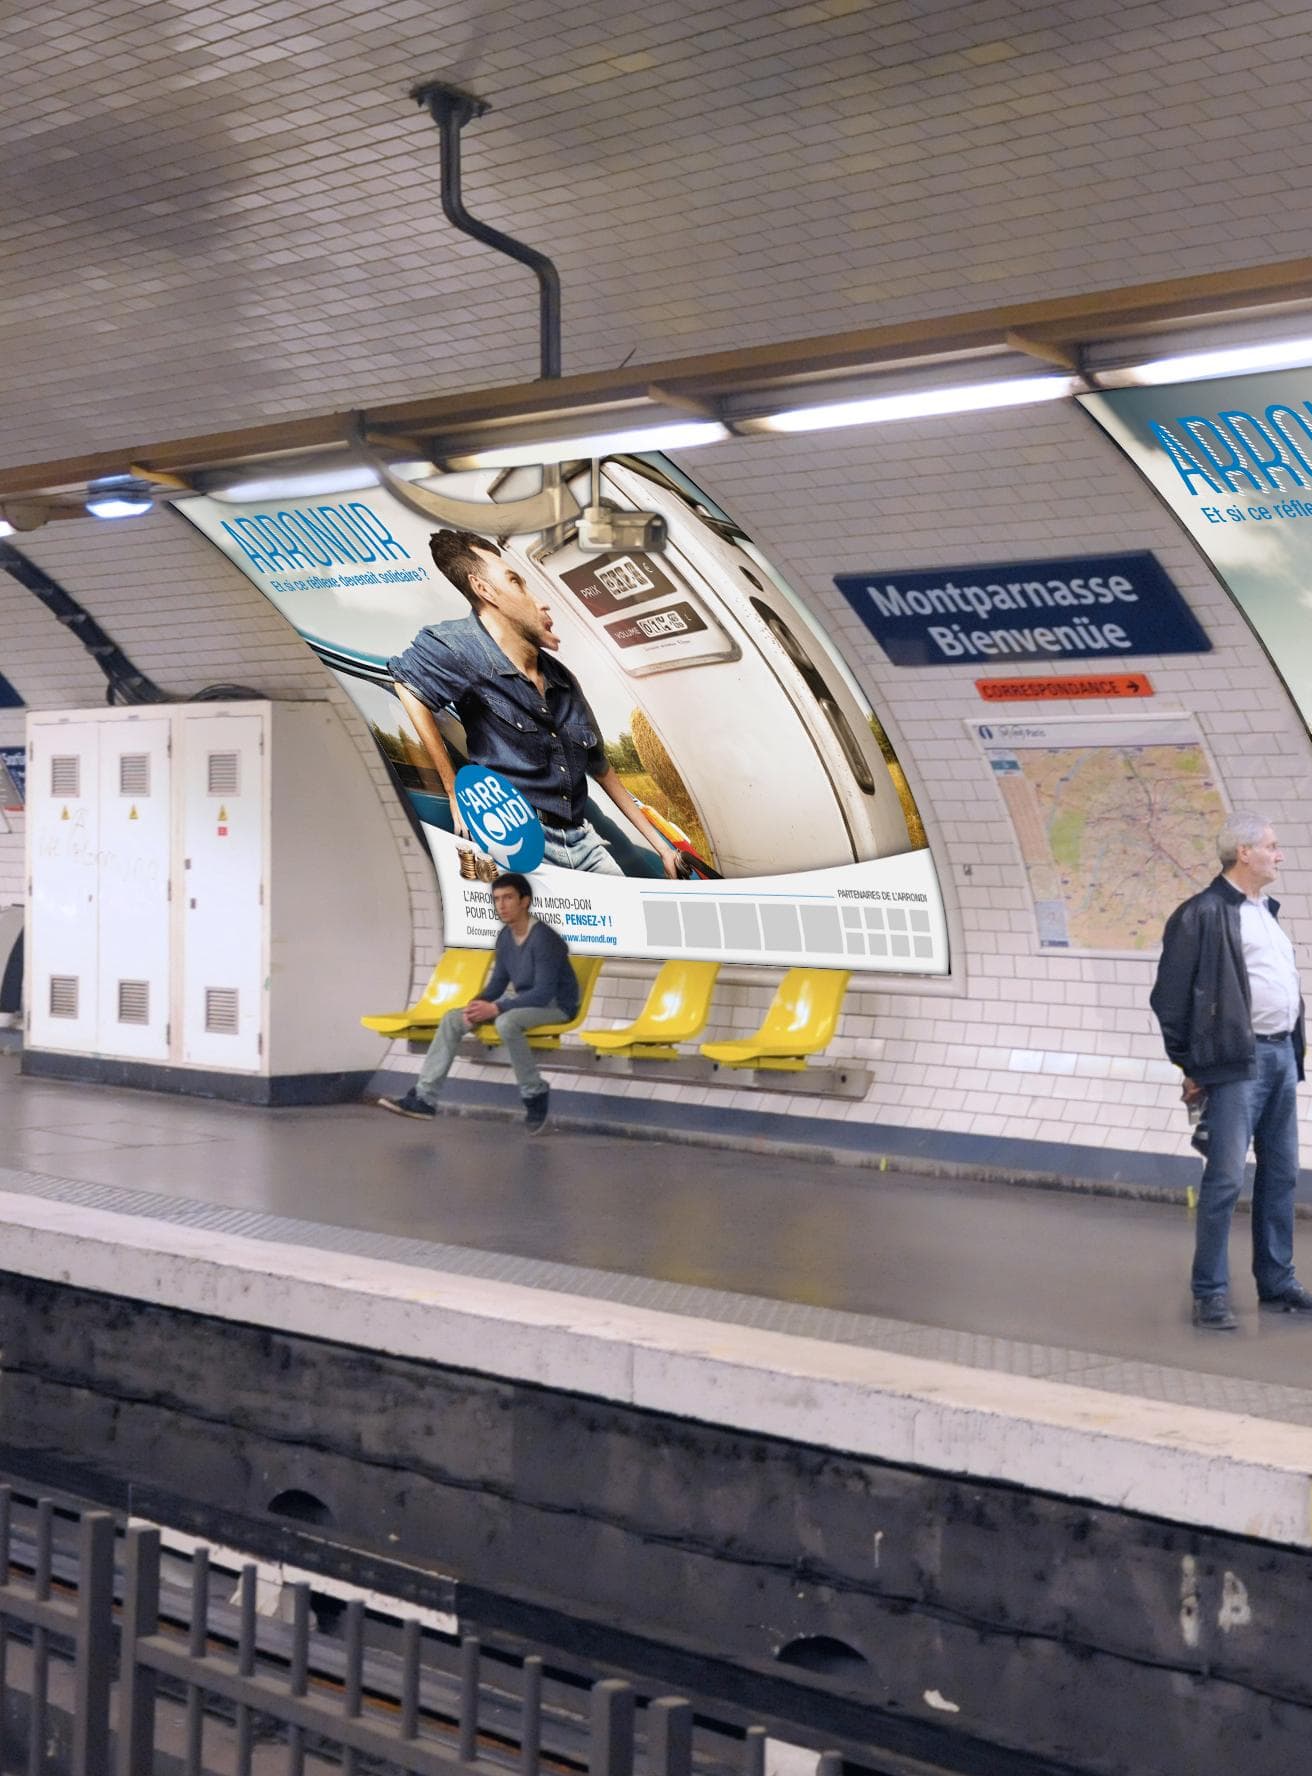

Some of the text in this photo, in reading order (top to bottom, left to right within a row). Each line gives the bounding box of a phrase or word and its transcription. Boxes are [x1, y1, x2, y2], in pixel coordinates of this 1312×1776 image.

[1200, 507, 1227, 524] Et
[1227, 505, 1247, 522] si
[1248, 505, 1272, 521] ce
[220, 502, 411, 574] ARRONDIR
[271, 580, 287, 593] Et
[294, 580, 309, 591] ce
[339, 571, 380, 587] devenait
[379, 568, 423, 585] solidaire
[580, 585, 603, 600] PRIX
[866, 574, 1139, 620] Montparnasse
[927, 616, 1133, 657] Bienvenüe
[982, 681, 1121, 697] CORRESPONDANCE
[458, 775, 508, 814] L'ARR
[545, 897, 592, 910] MICRO-DON
[837, 889, 881, 901] PARTENAIRES
[881, 891, 892, 901] DE
[466, 906, 487, 919] POUR
[565, 913, 606, 927] PENSEZ-Y
[467, 926, 497, 937] Découvrez
